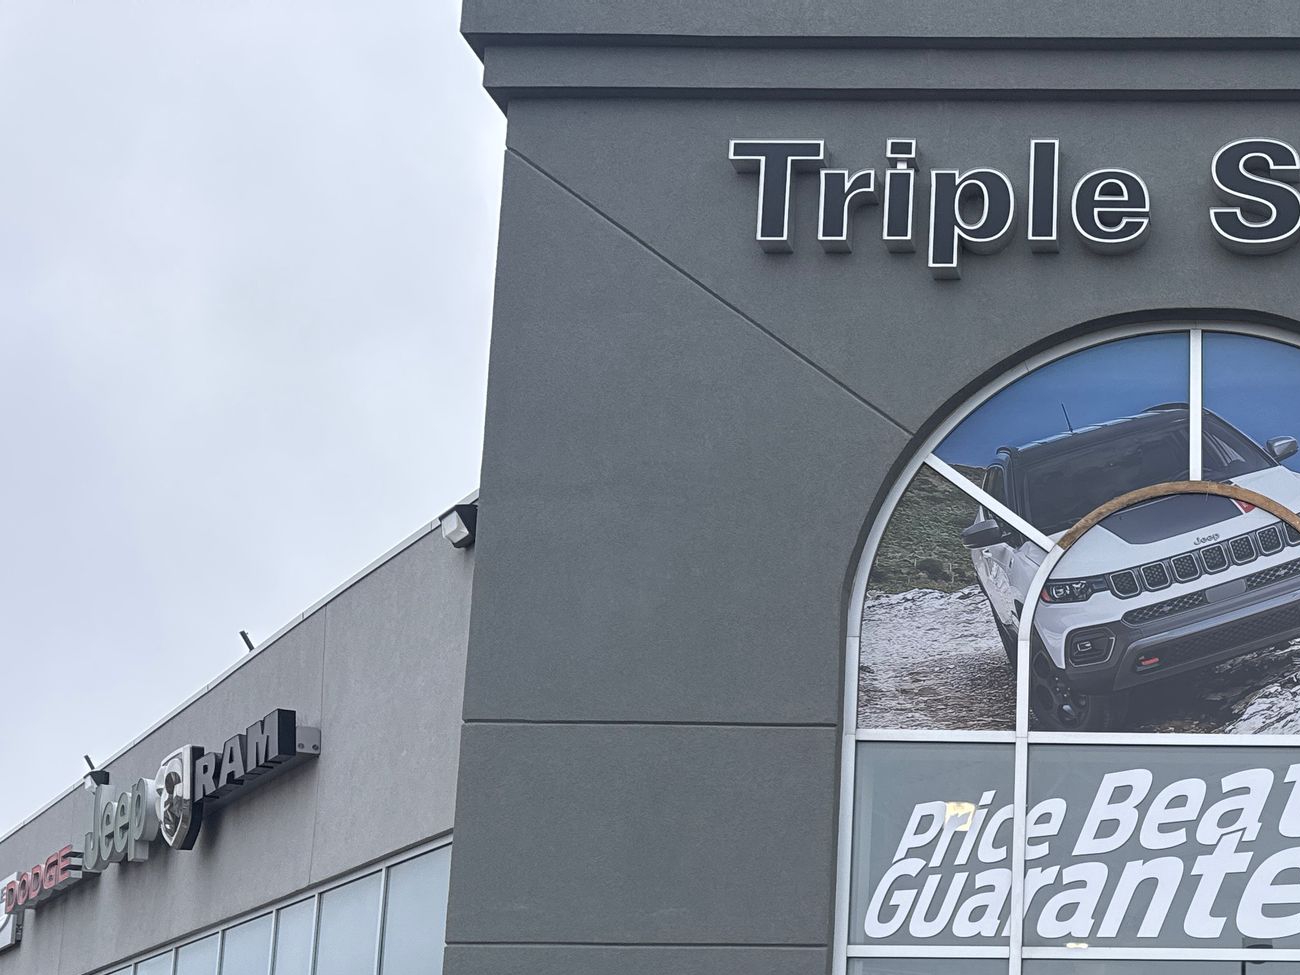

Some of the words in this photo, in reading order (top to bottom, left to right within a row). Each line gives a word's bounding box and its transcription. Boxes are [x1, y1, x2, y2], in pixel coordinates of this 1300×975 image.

[729, 138, 1151, 269] Triple
[1193, 533, 1220, 546] Jeep
[195, 708, 286, 802] RAM
[84, 778, 147, 871] Jeep
[892, 790, 1068, 866] Price
[5, 844, 73, 913] DODGE
